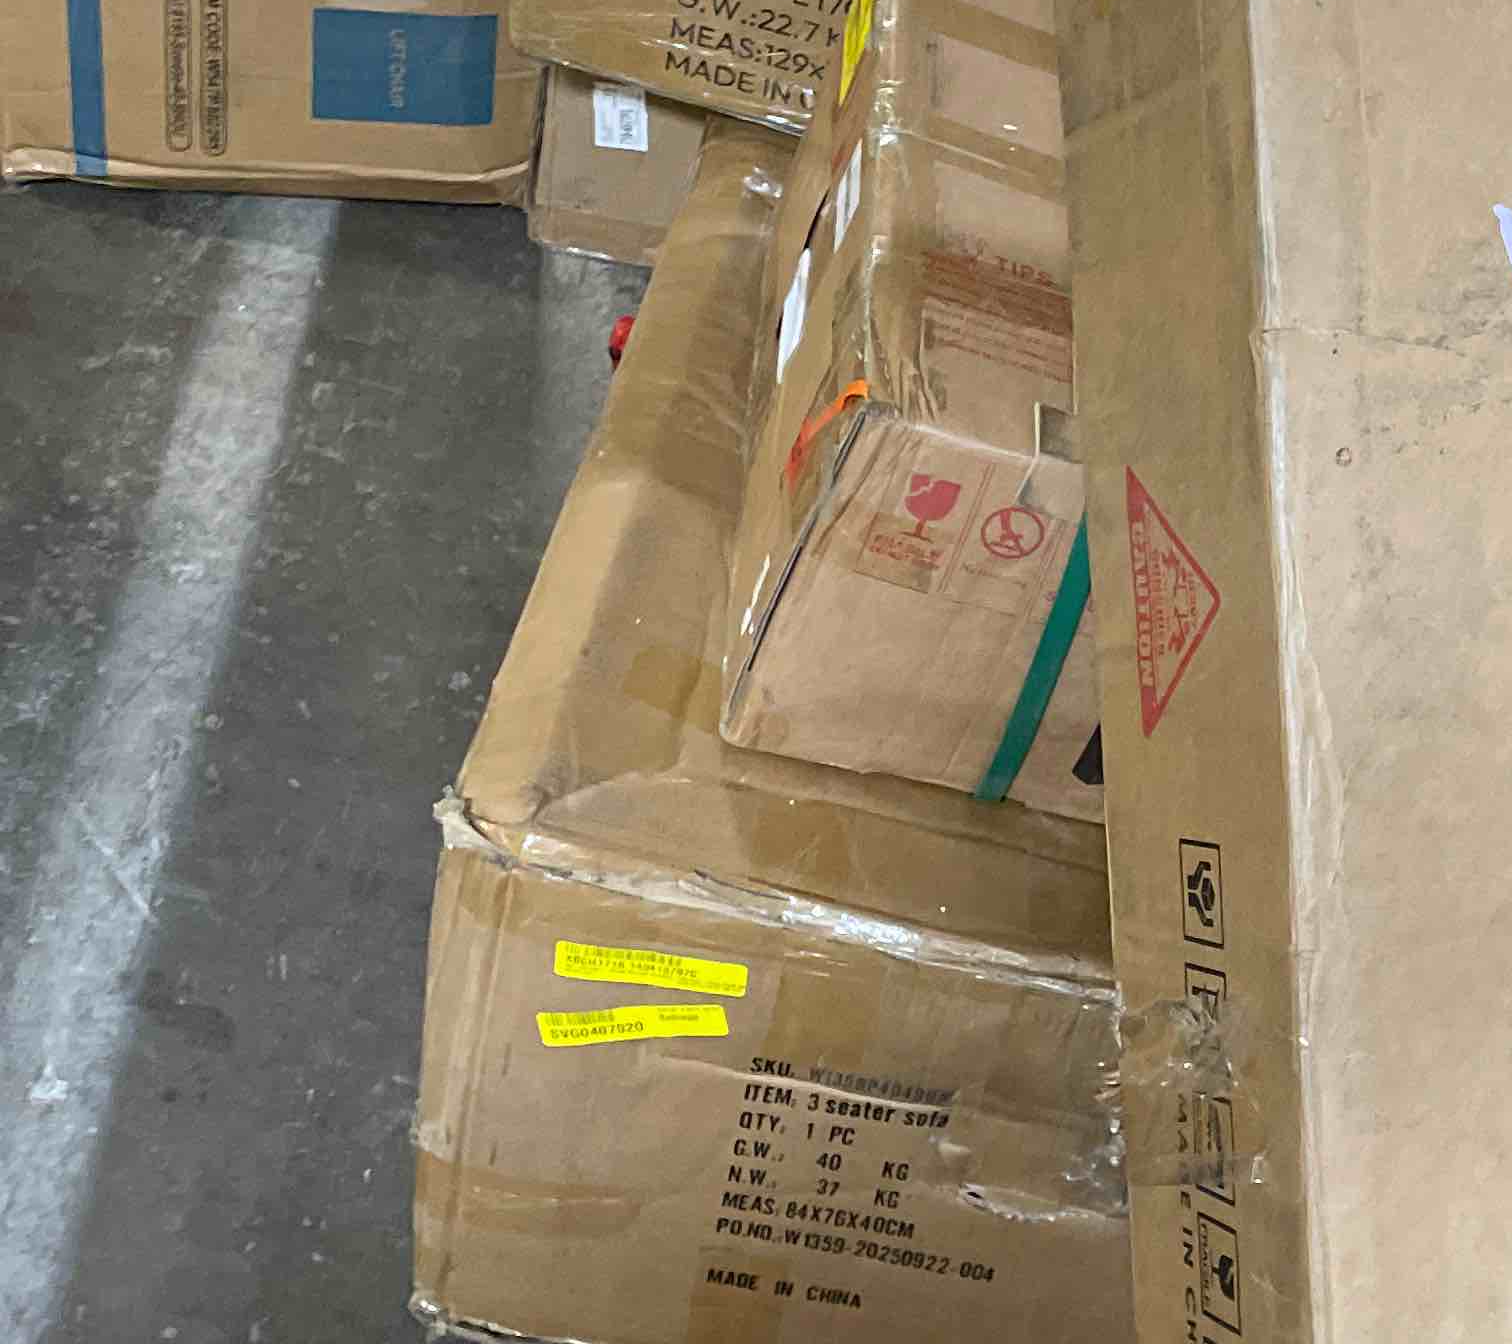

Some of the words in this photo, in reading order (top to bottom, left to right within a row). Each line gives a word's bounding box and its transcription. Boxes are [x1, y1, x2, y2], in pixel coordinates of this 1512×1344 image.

[664, 50, 755, 94] MADE
[762, 77, 792, 105] IN
[807, 1092, 820, 1112] 3
[825, 1097, 897, 1124] seater
[902, 1108, 951, 1130] sofa
[806, 1122, 815, 1141] 1
[828, 1125, 856, 1147] PC
[1175, 1093, 1194, 1209] MAE
[816, 1152, 842, 1173] 40
[881, 1160, 910, 1183] KG
[816, 1178, 841, 1198] 37
[873, 1188, 901, 1210] KG
[1180, 1225, 1194, 1269] IN
[706, 1267, 759, 1292] MADE
[773, 1280, 794, 1298] IN
[805, 1285, 862, 1309] CHINA
